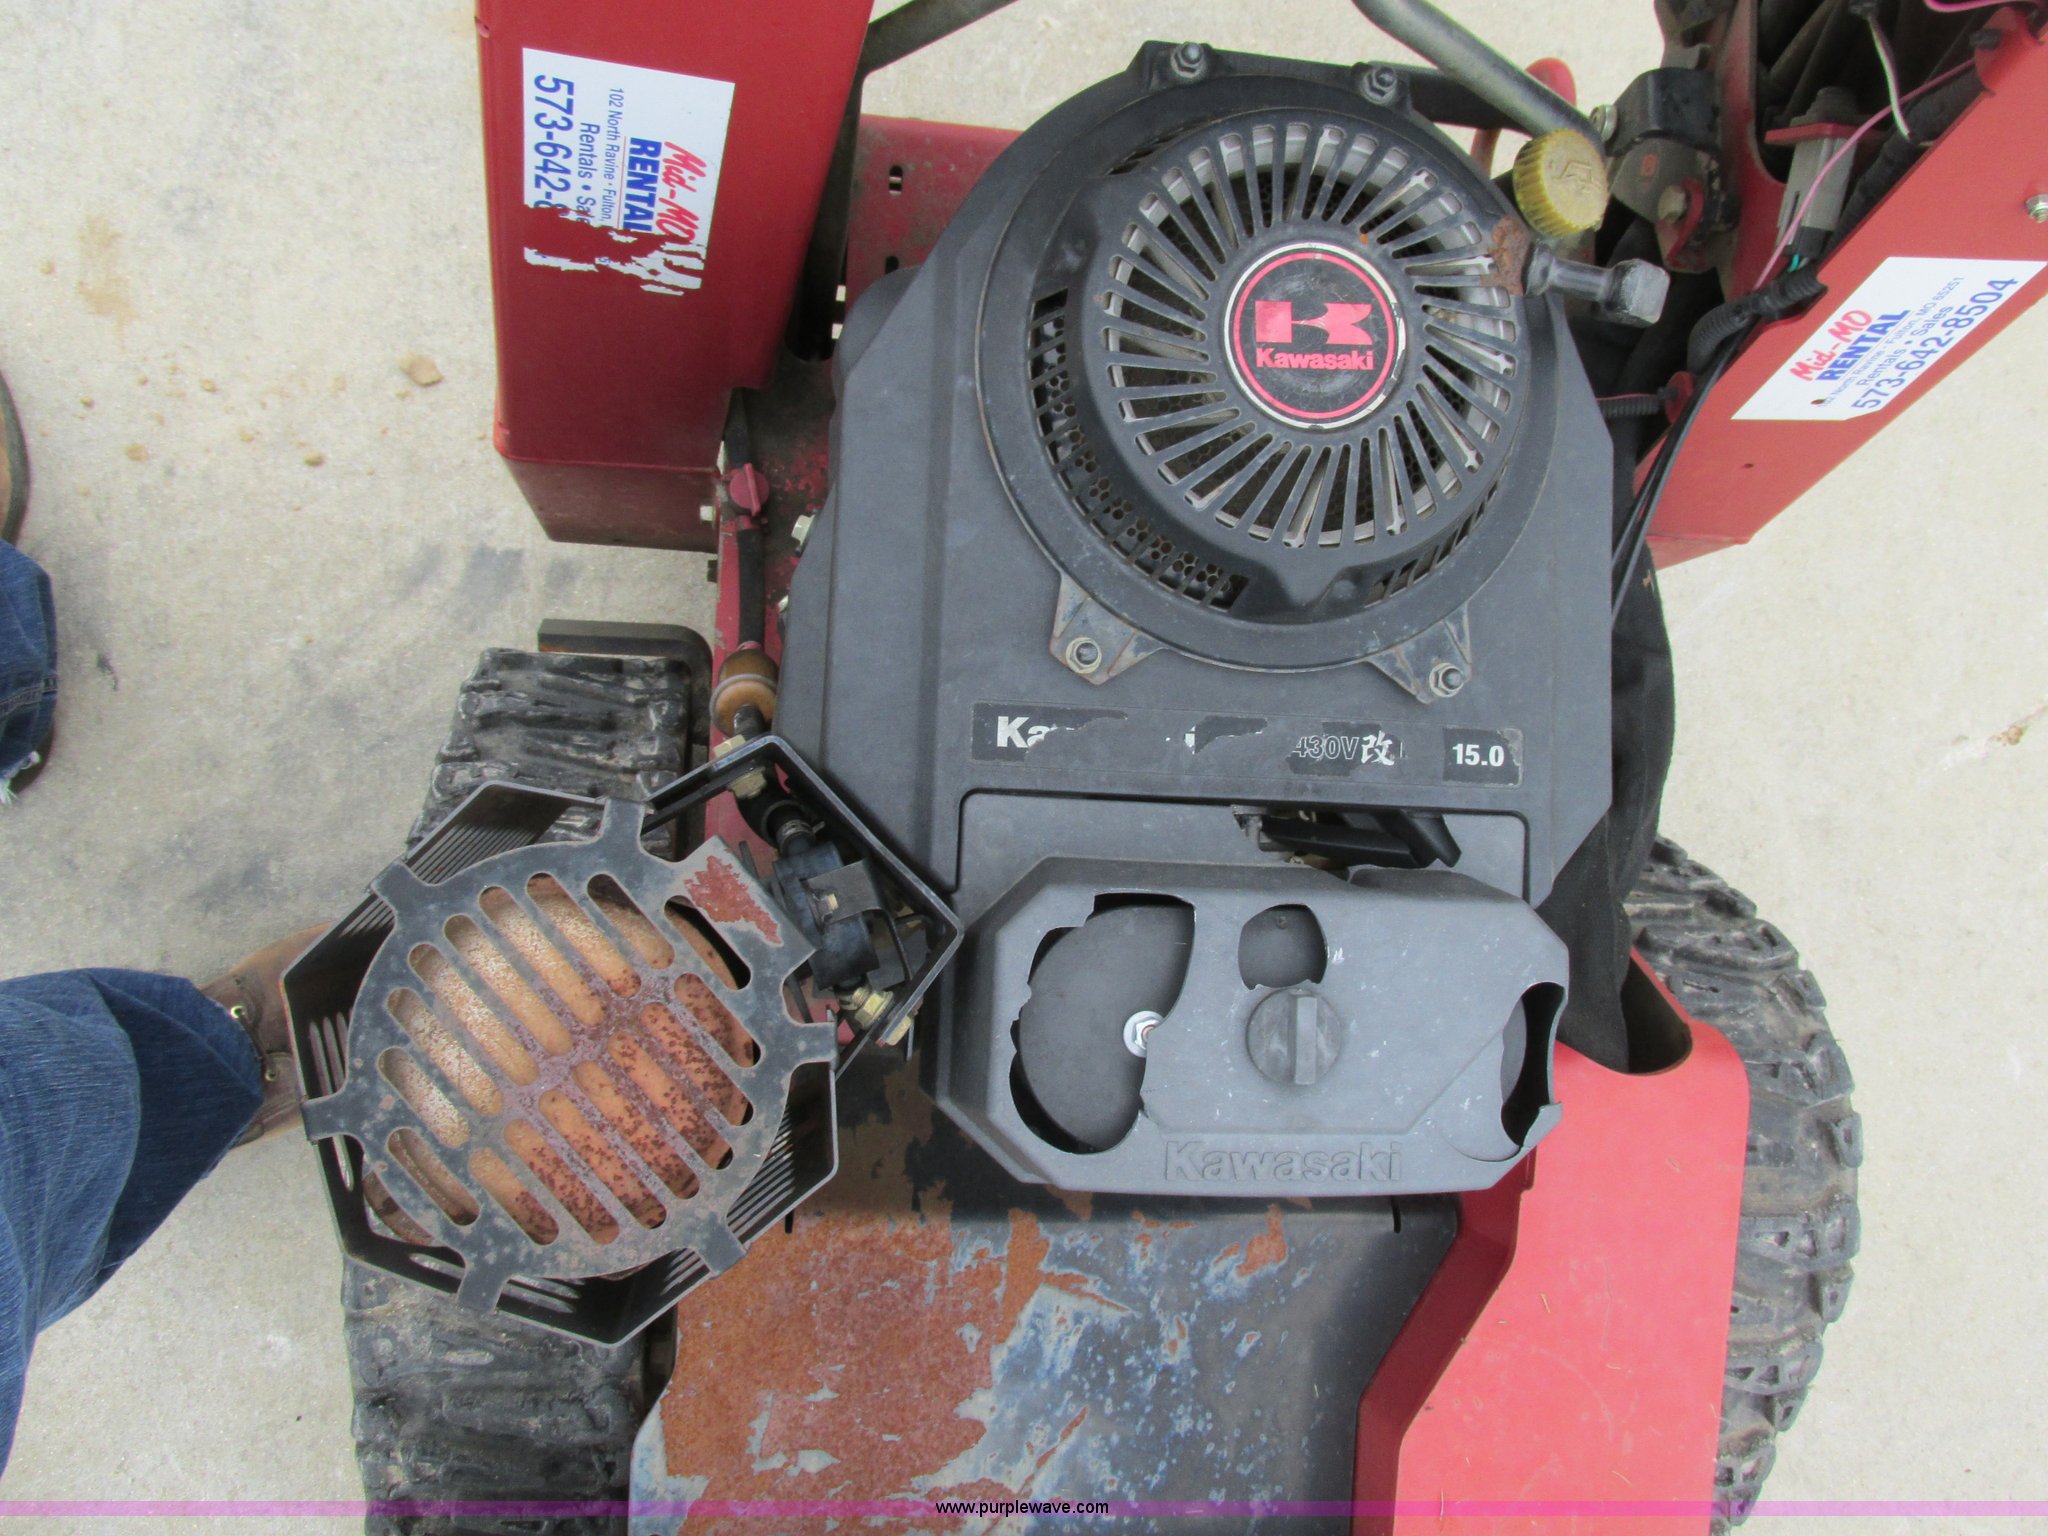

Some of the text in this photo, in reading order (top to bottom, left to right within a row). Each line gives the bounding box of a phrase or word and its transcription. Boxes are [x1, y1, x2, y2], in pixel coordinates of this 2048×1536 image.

[578, 122, 600, 179] Rentals
[600, 88, 624, 221] 102 North Ravine Fulton,
[656, 141, 707, 242] Mid-MO
[1256, 347, 1375, 370] Kawasaki
[1790, 310, 1872, 381] Mid-MO
[1815, 309, 1911, 381] RENTAL
[1850, 278, 2019, 409] 573-642-8504
[1854, 306, 1955, 385] Rentals Sales
[1453, 743, 1505, 767] 15.0
[1164, 1141, 1403, 1182] Kawasaki
